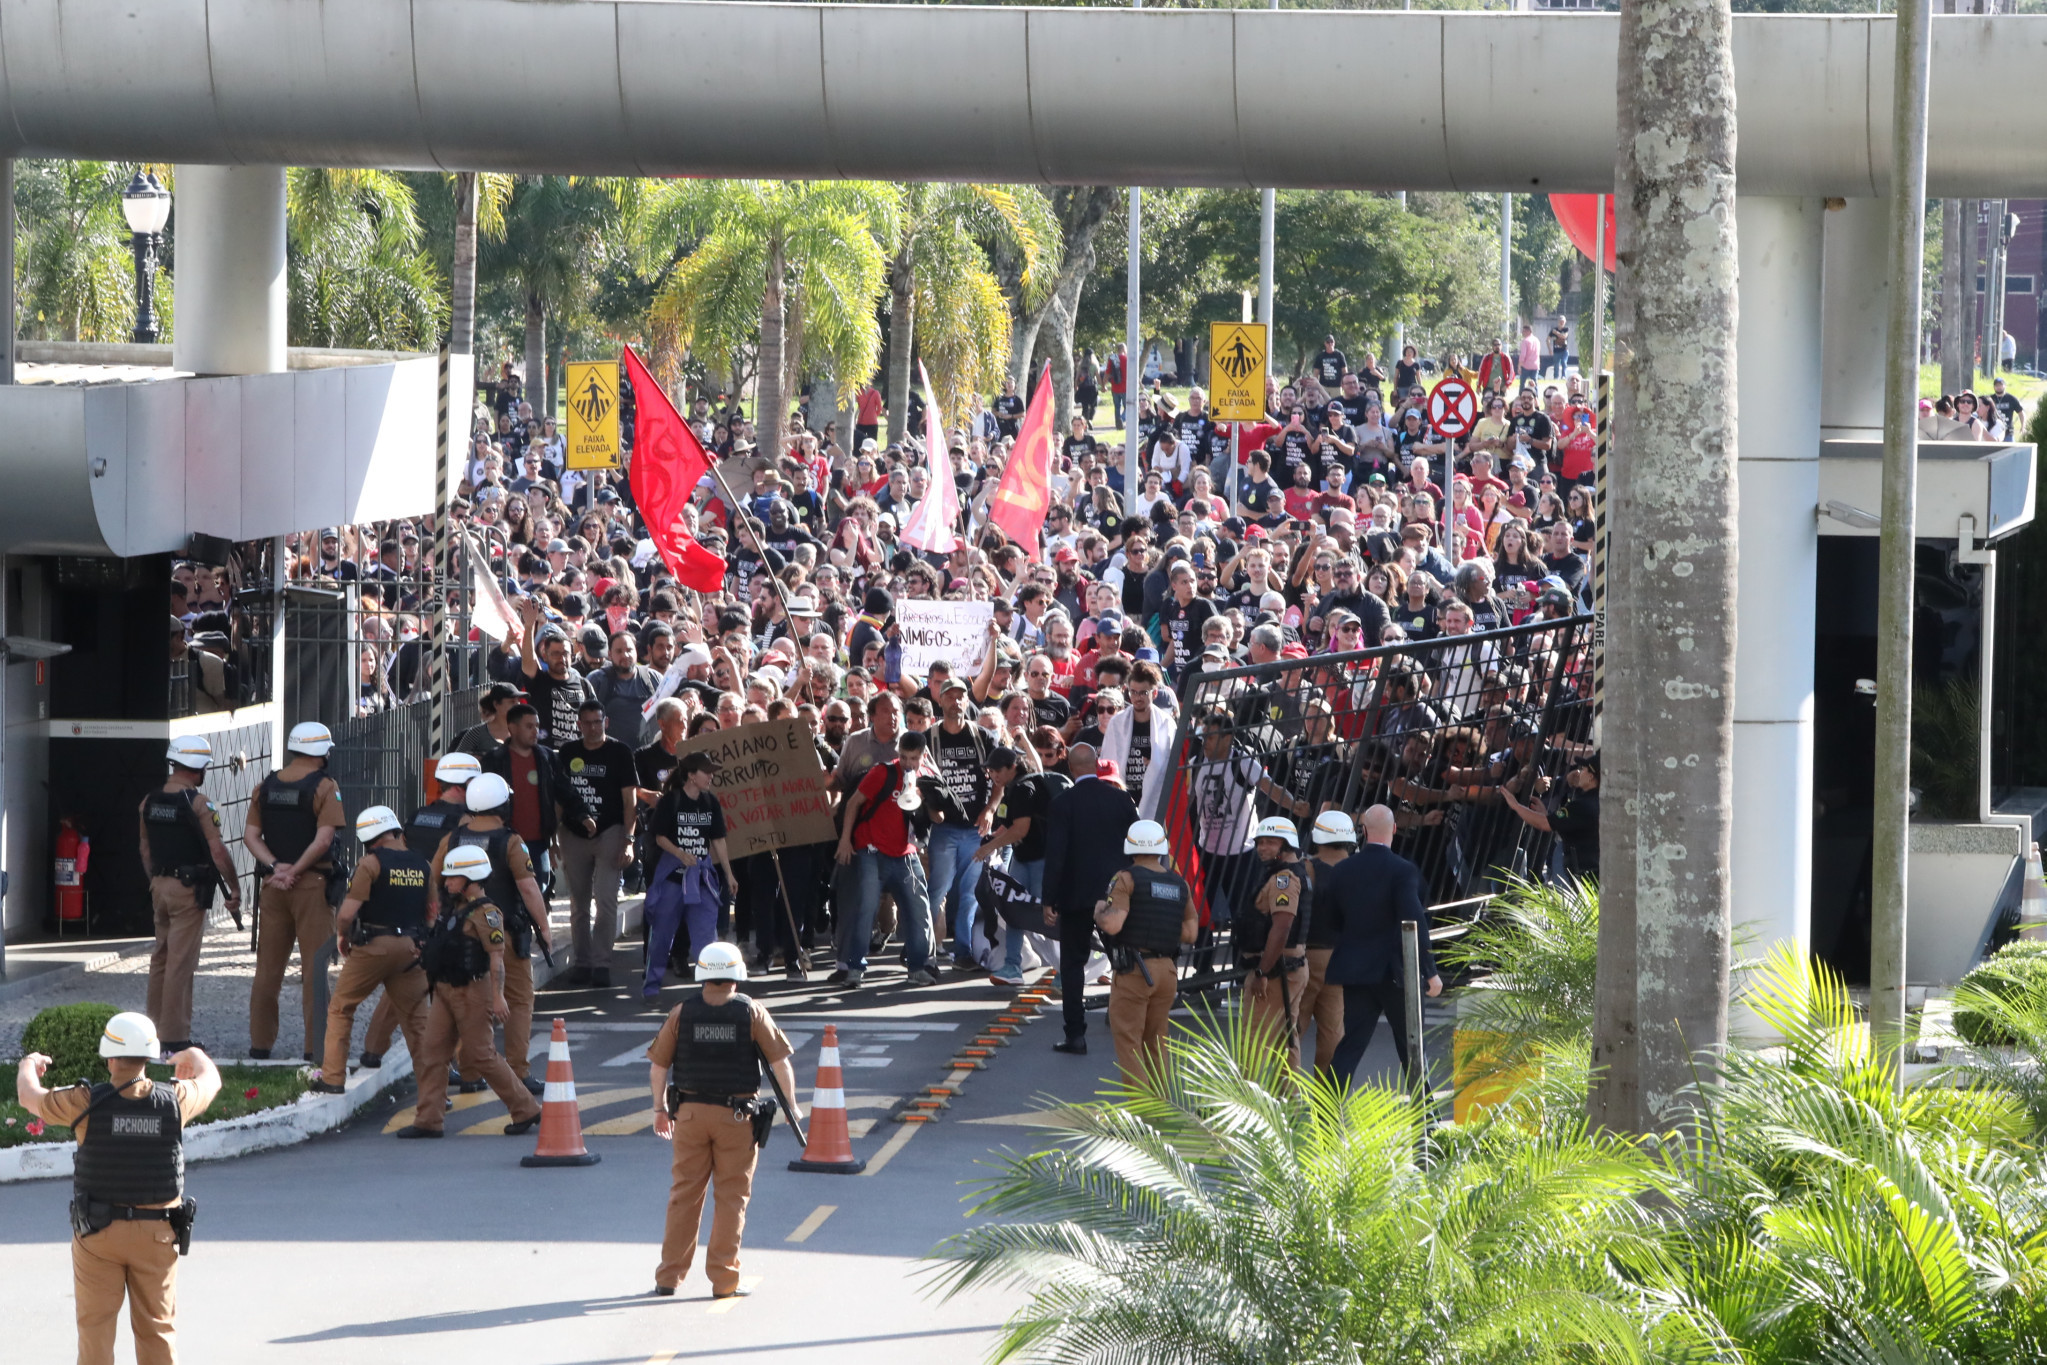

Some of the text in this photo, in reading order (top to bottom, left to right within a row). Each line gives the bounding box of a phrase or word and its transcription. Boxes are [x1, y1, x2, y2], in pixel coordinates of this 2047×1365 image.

[1227, 389, 1250, 397] FAIXA
[1218, 398, 1256, 406] ELEVADA
[583, 434, 606, 443] FAIXA
[576, 444, 611, 454] ELEVADA
[434, 568, 444, 603] PARE
[1595, 612, 1605, 648] PARE
[786, 723, 799, 750] É
[711, 759, 780, 788] ORRUPTO
[570, 776, 588, 786] Não
[740, 784, 777, 803] TEM
[782, 777, 821, 796] MORAL
[740, 803, 785, 825] VOTAR
[677, 826, 700, 837] Não
[748, 830, 787, 851] PSTU
[390, 868, 425, 879] POLÍCIA
[389, 878, 425, 888] MILITAR
[695, 1026, 735, 1040] BPCHOQUE
[113, 1117, 160, 1134] BPCHOQUE
